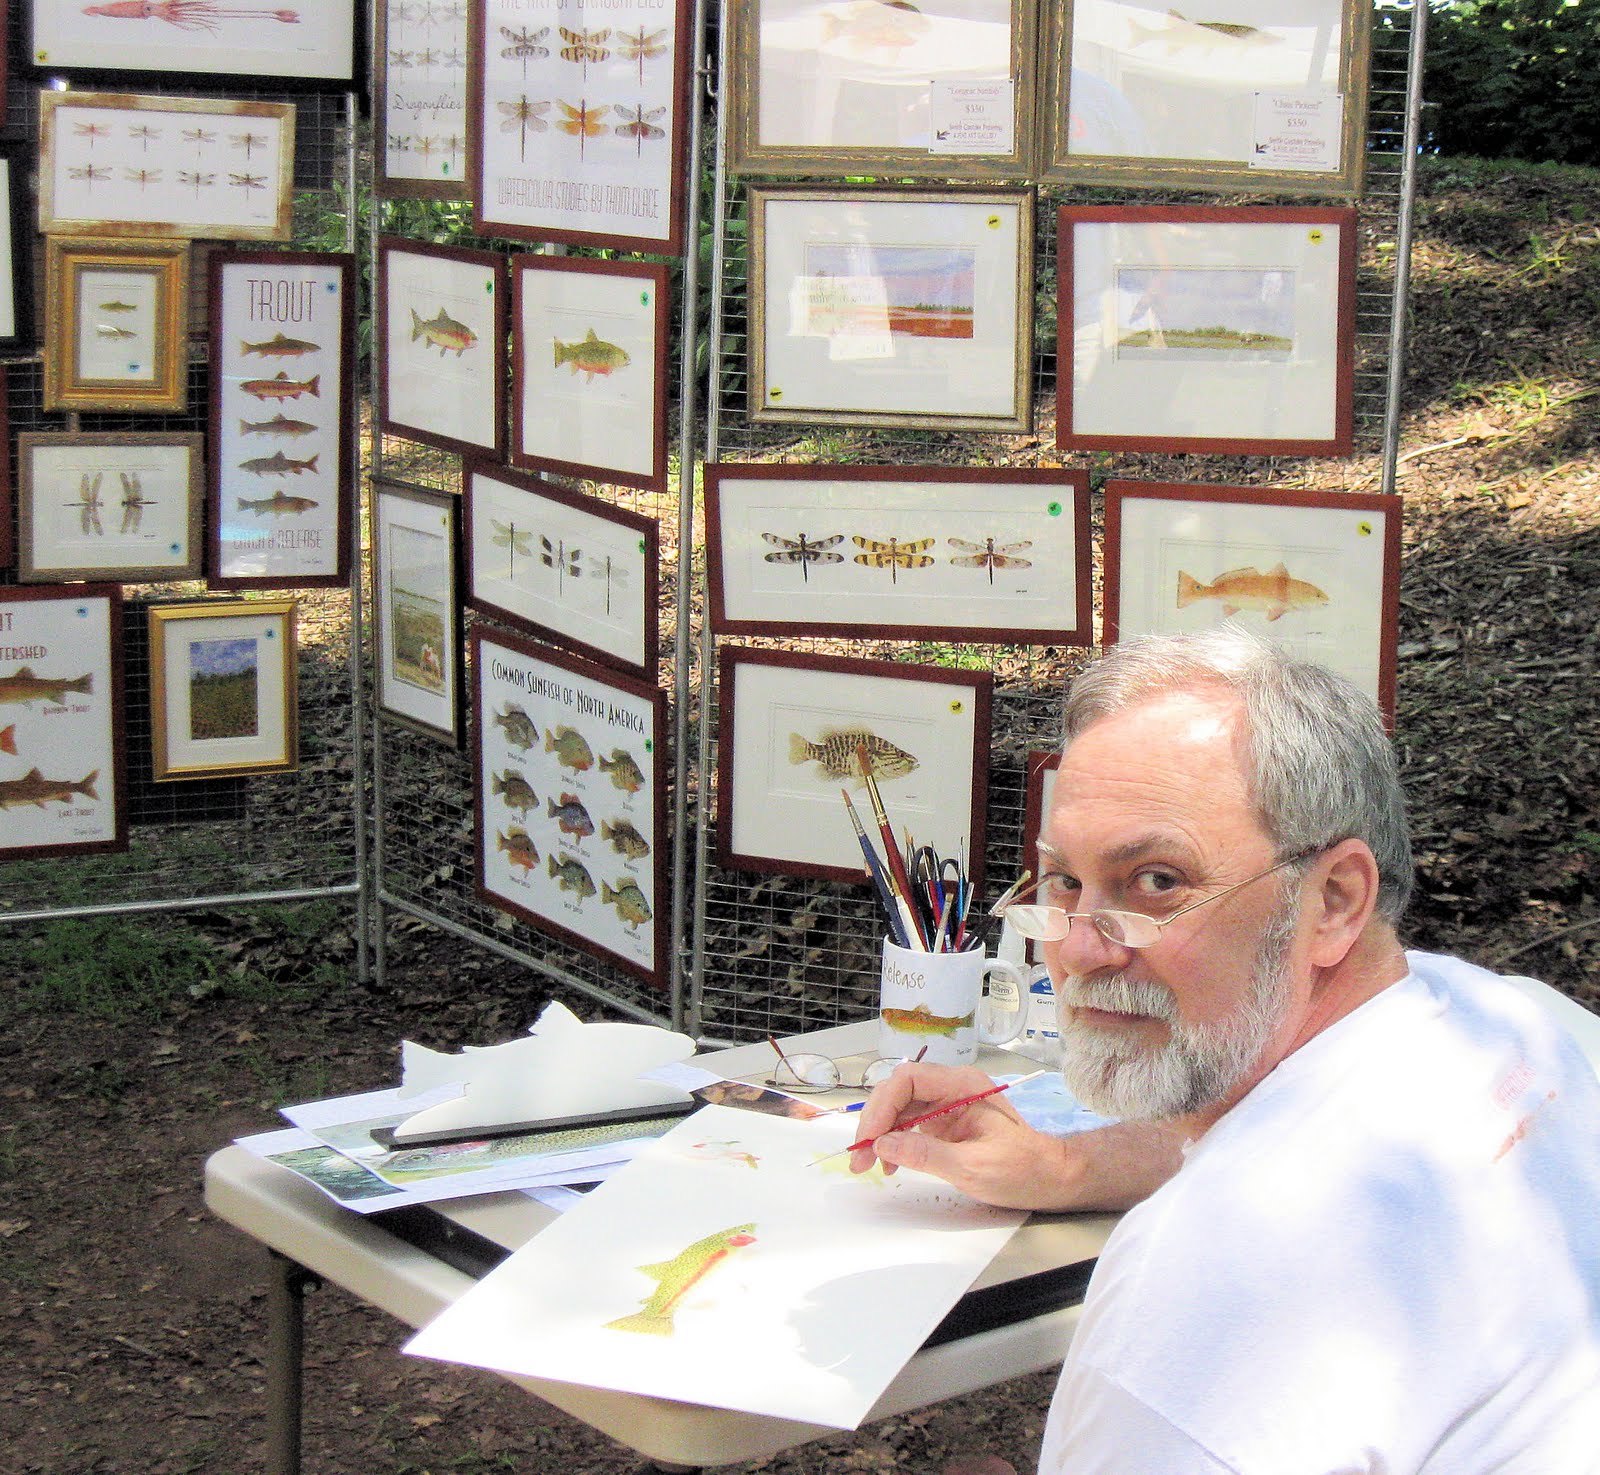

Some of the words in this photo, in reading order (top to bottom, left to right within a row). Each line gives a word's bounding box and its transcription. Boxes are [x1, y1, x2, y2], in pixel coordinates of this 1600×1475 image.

[393, 93, 463, 120] Dragonflies
[498, 177, 553, 208] WATERCOLOR
[556, 181, 589, 212] STUDIES
[591, 185, 602, 213] BY
[605, 185, 630, 216] THOM
[247, 280, 317, 322] TROUT
[277, 529, 321, 549] RELEASE
